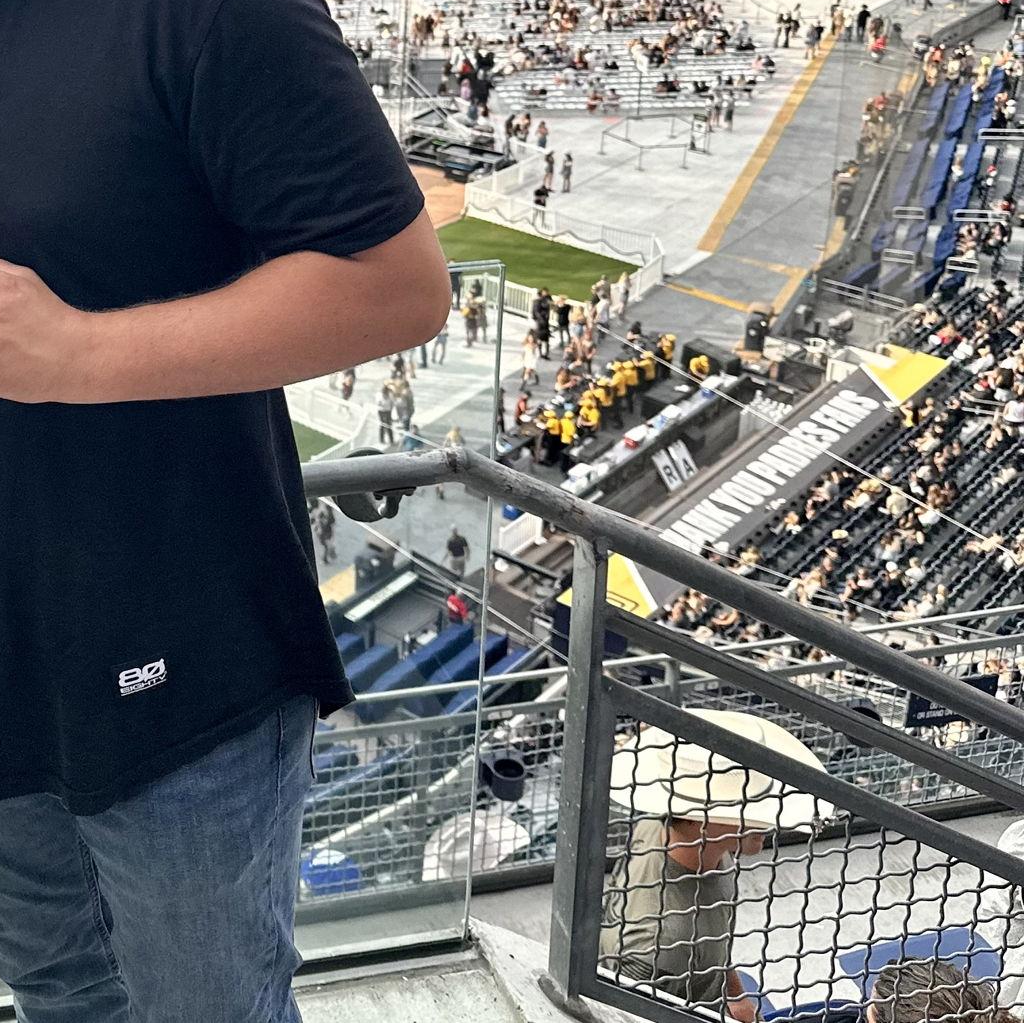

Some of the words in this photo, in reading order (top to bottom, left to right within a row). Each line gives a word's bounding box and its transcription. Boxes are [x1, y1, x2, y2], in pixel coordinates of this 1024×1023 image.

[708, 470, 777, 514] YOU
[746, 421, 842, 487] PADRES
[810, 389, 881, 434] FANS
